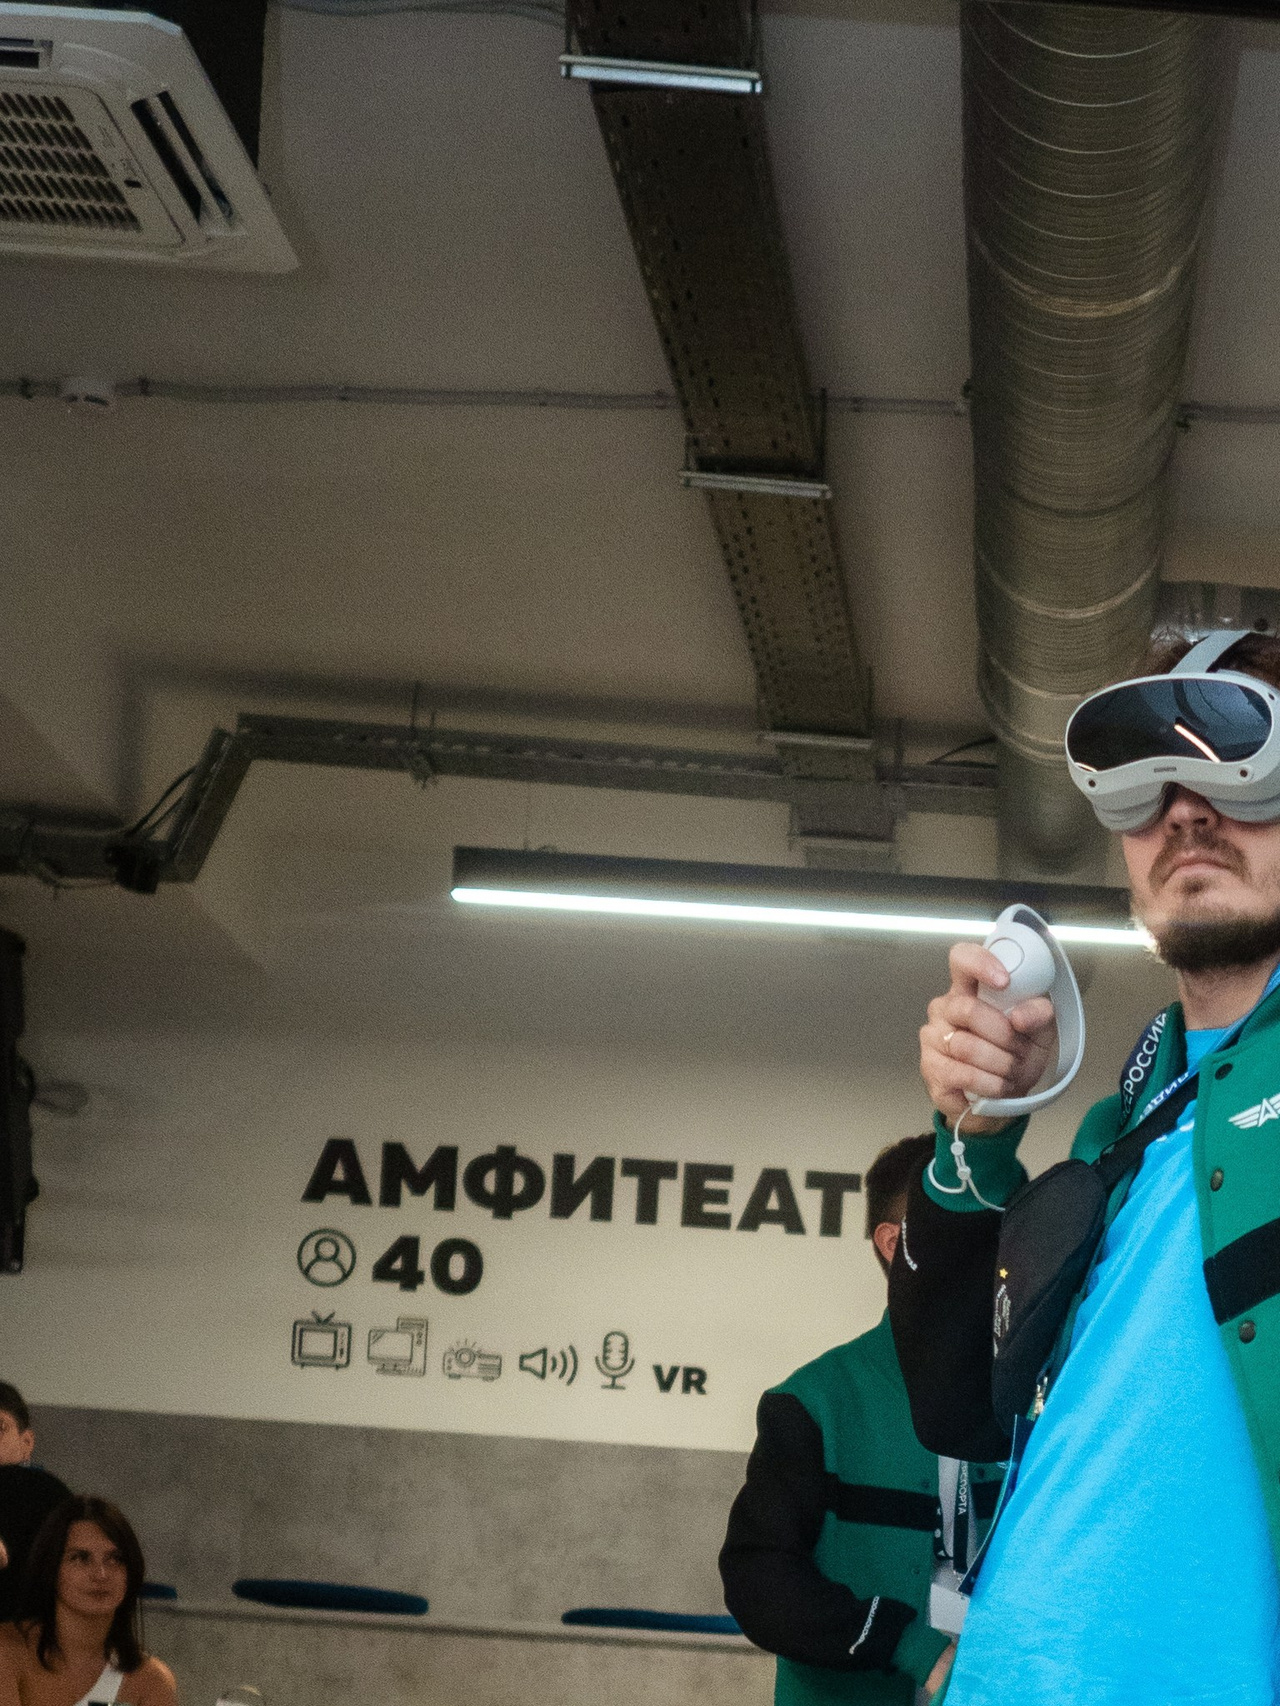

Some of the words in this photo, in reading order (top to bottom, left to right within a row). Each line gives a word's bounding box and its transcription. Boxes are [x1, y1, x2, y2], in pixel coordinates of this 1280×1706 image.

[301, 1137, 872, 1241] АМФИТЕАТ
[372, 1235, 484, 1296] 40
[653, 1364, 708, 1395] VR
